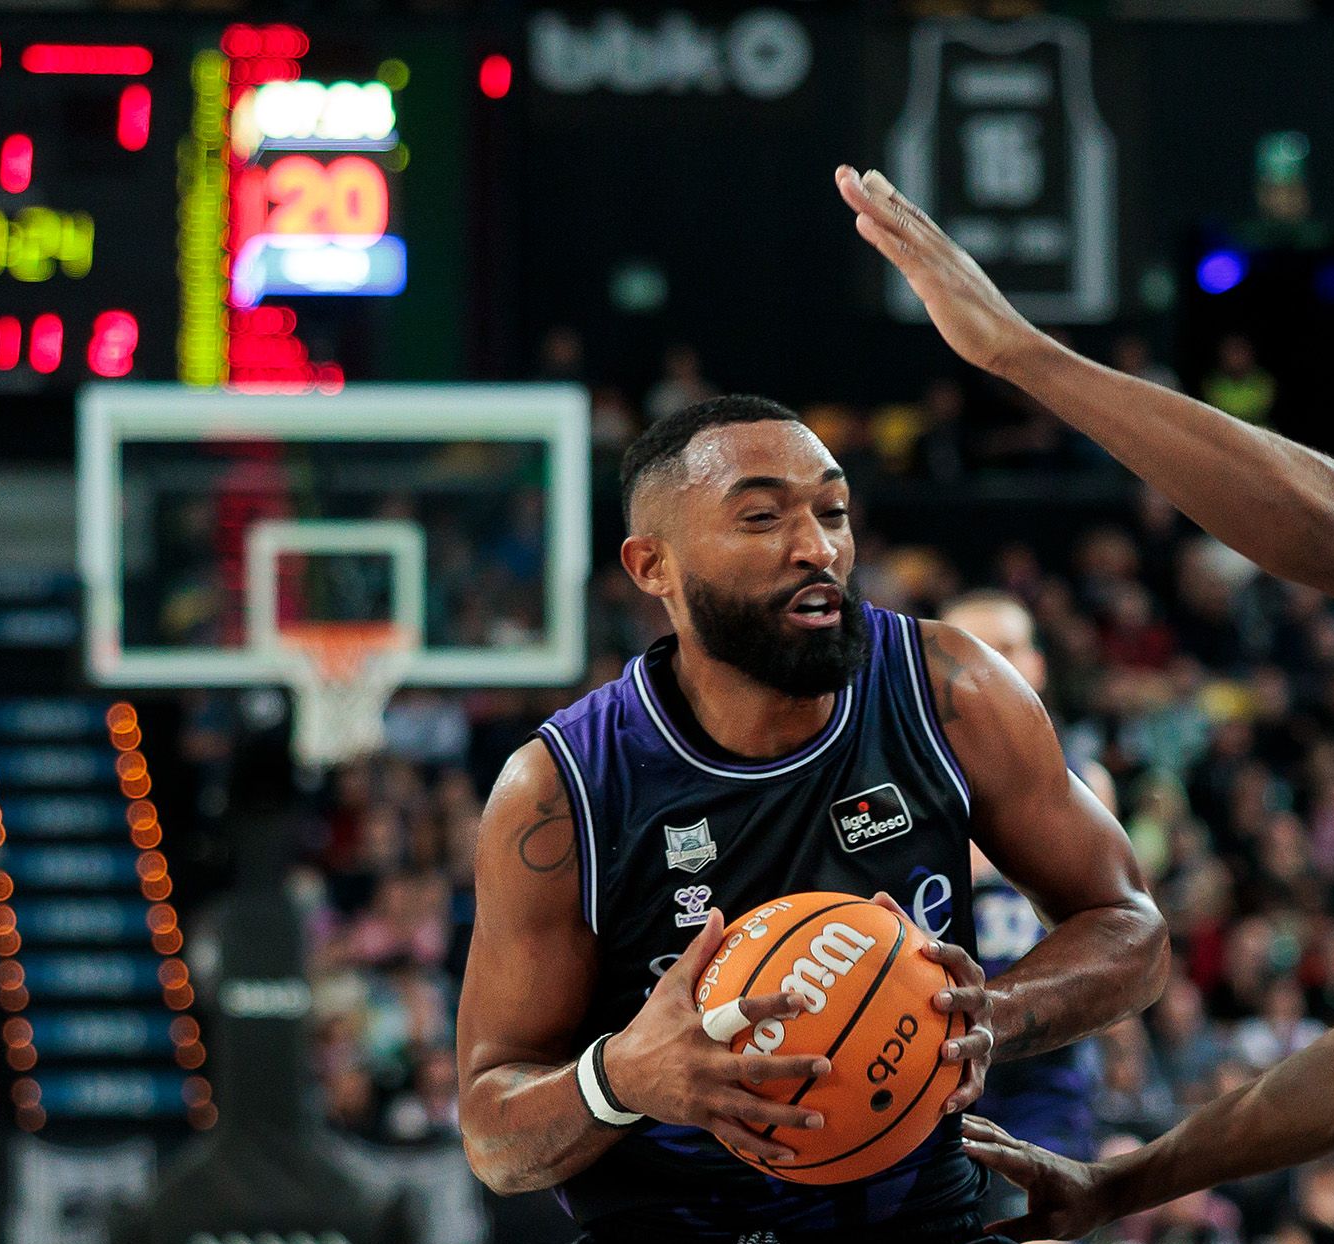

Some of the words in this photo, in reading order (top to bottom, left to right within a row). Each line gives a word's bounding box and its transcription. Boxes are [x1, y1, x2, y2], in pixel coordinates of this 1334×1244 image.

[841, 812, 871, 831] liga
[847, 814, 906, 843] endesa
[867, 1013, 919, 1085] acb
